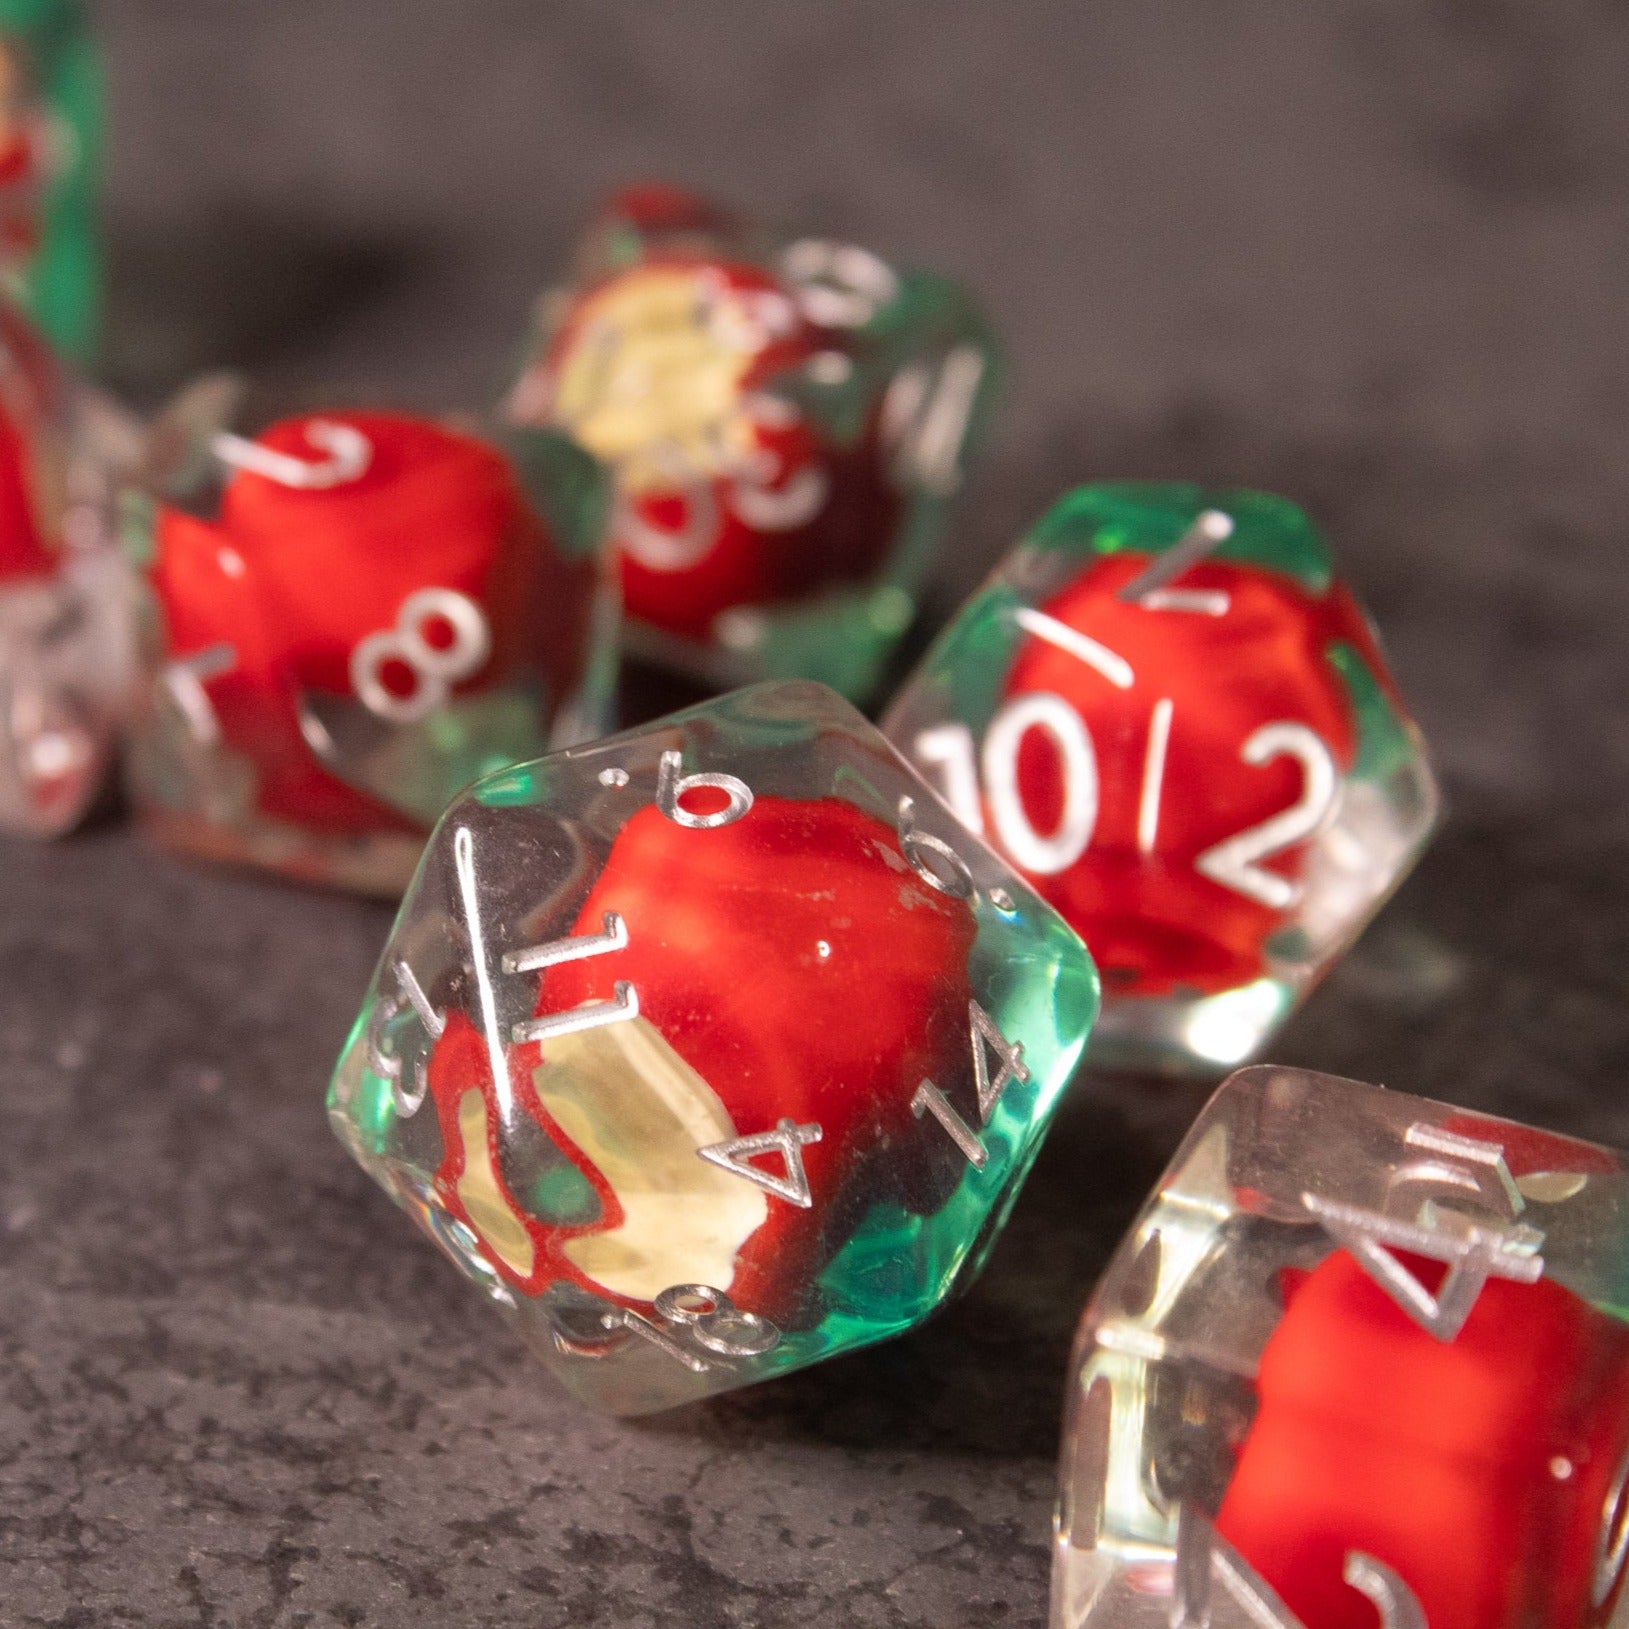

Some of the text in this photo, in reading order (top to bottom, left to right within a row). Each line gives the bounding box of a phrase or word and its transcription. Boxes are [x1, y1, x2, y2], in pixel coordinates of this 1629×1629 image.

[351, 586, 491, 724] 8
[914, 692, 1098, 874] 10
[1194, 719, 1335, 909] 2
[910, 999, 1032, 1171] 14
[698, 1118, 823, 1208] 4
[601, 1283, 781, 1373] 18
